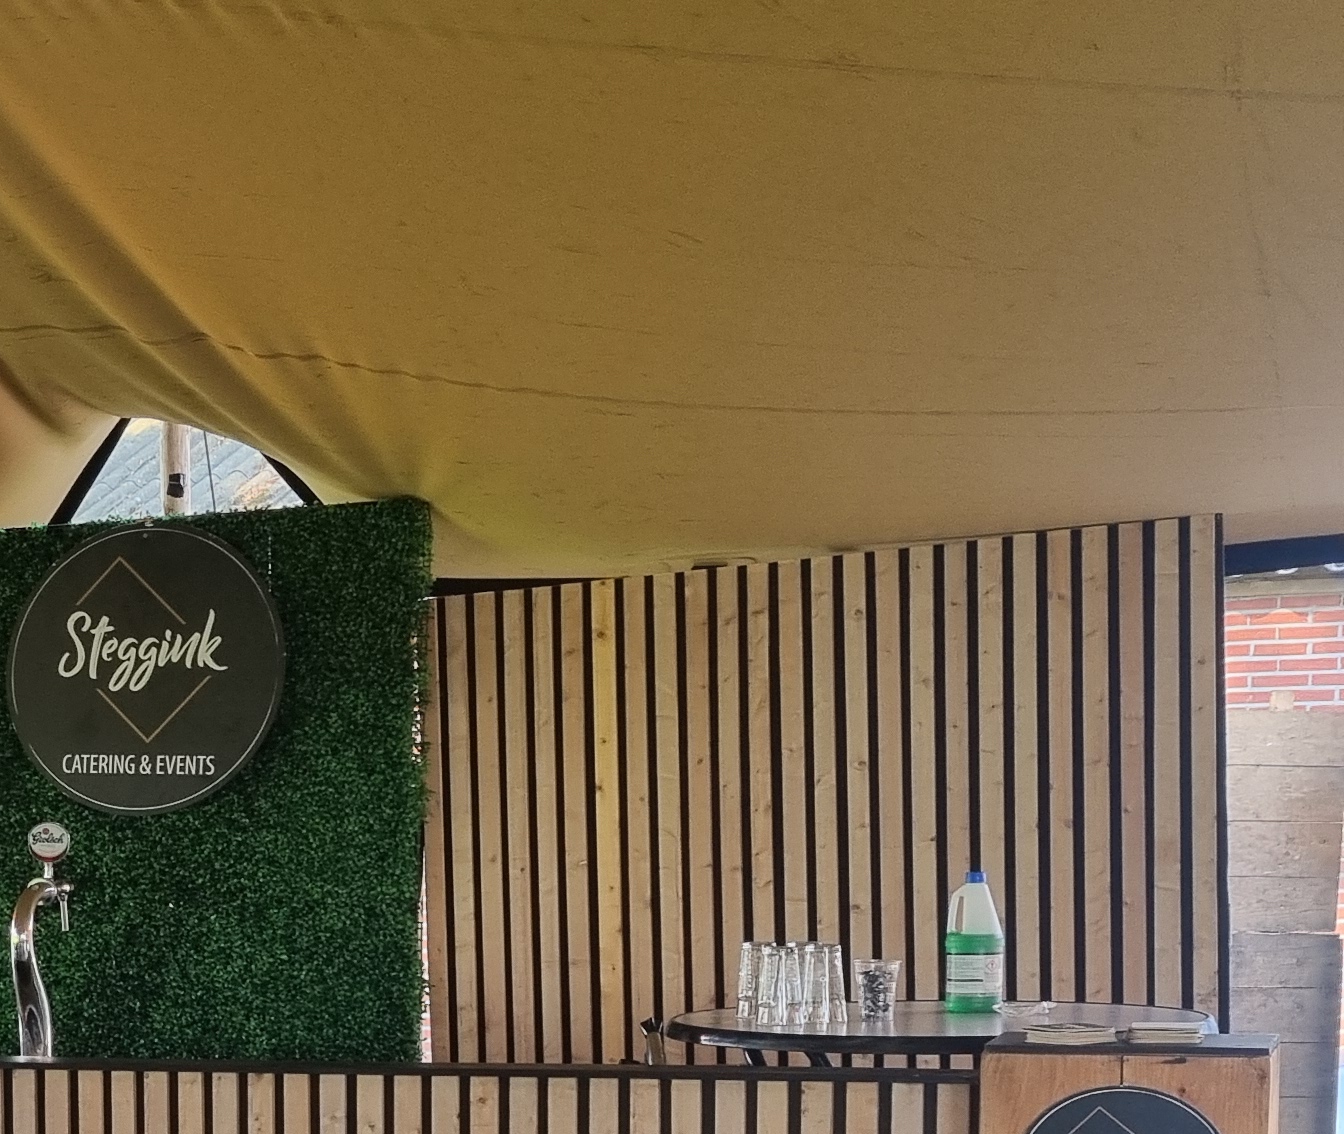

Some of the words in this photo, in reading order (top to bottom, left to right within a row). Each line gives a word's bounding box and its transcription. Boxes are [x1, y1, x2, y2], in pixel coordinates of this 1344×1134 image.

[58, 608, 228, 692] Steggink
[62, 754, 136, 775] CATERING
[139, 755, 152, 775] &
[156, 755, 215, 776] EVENTS
